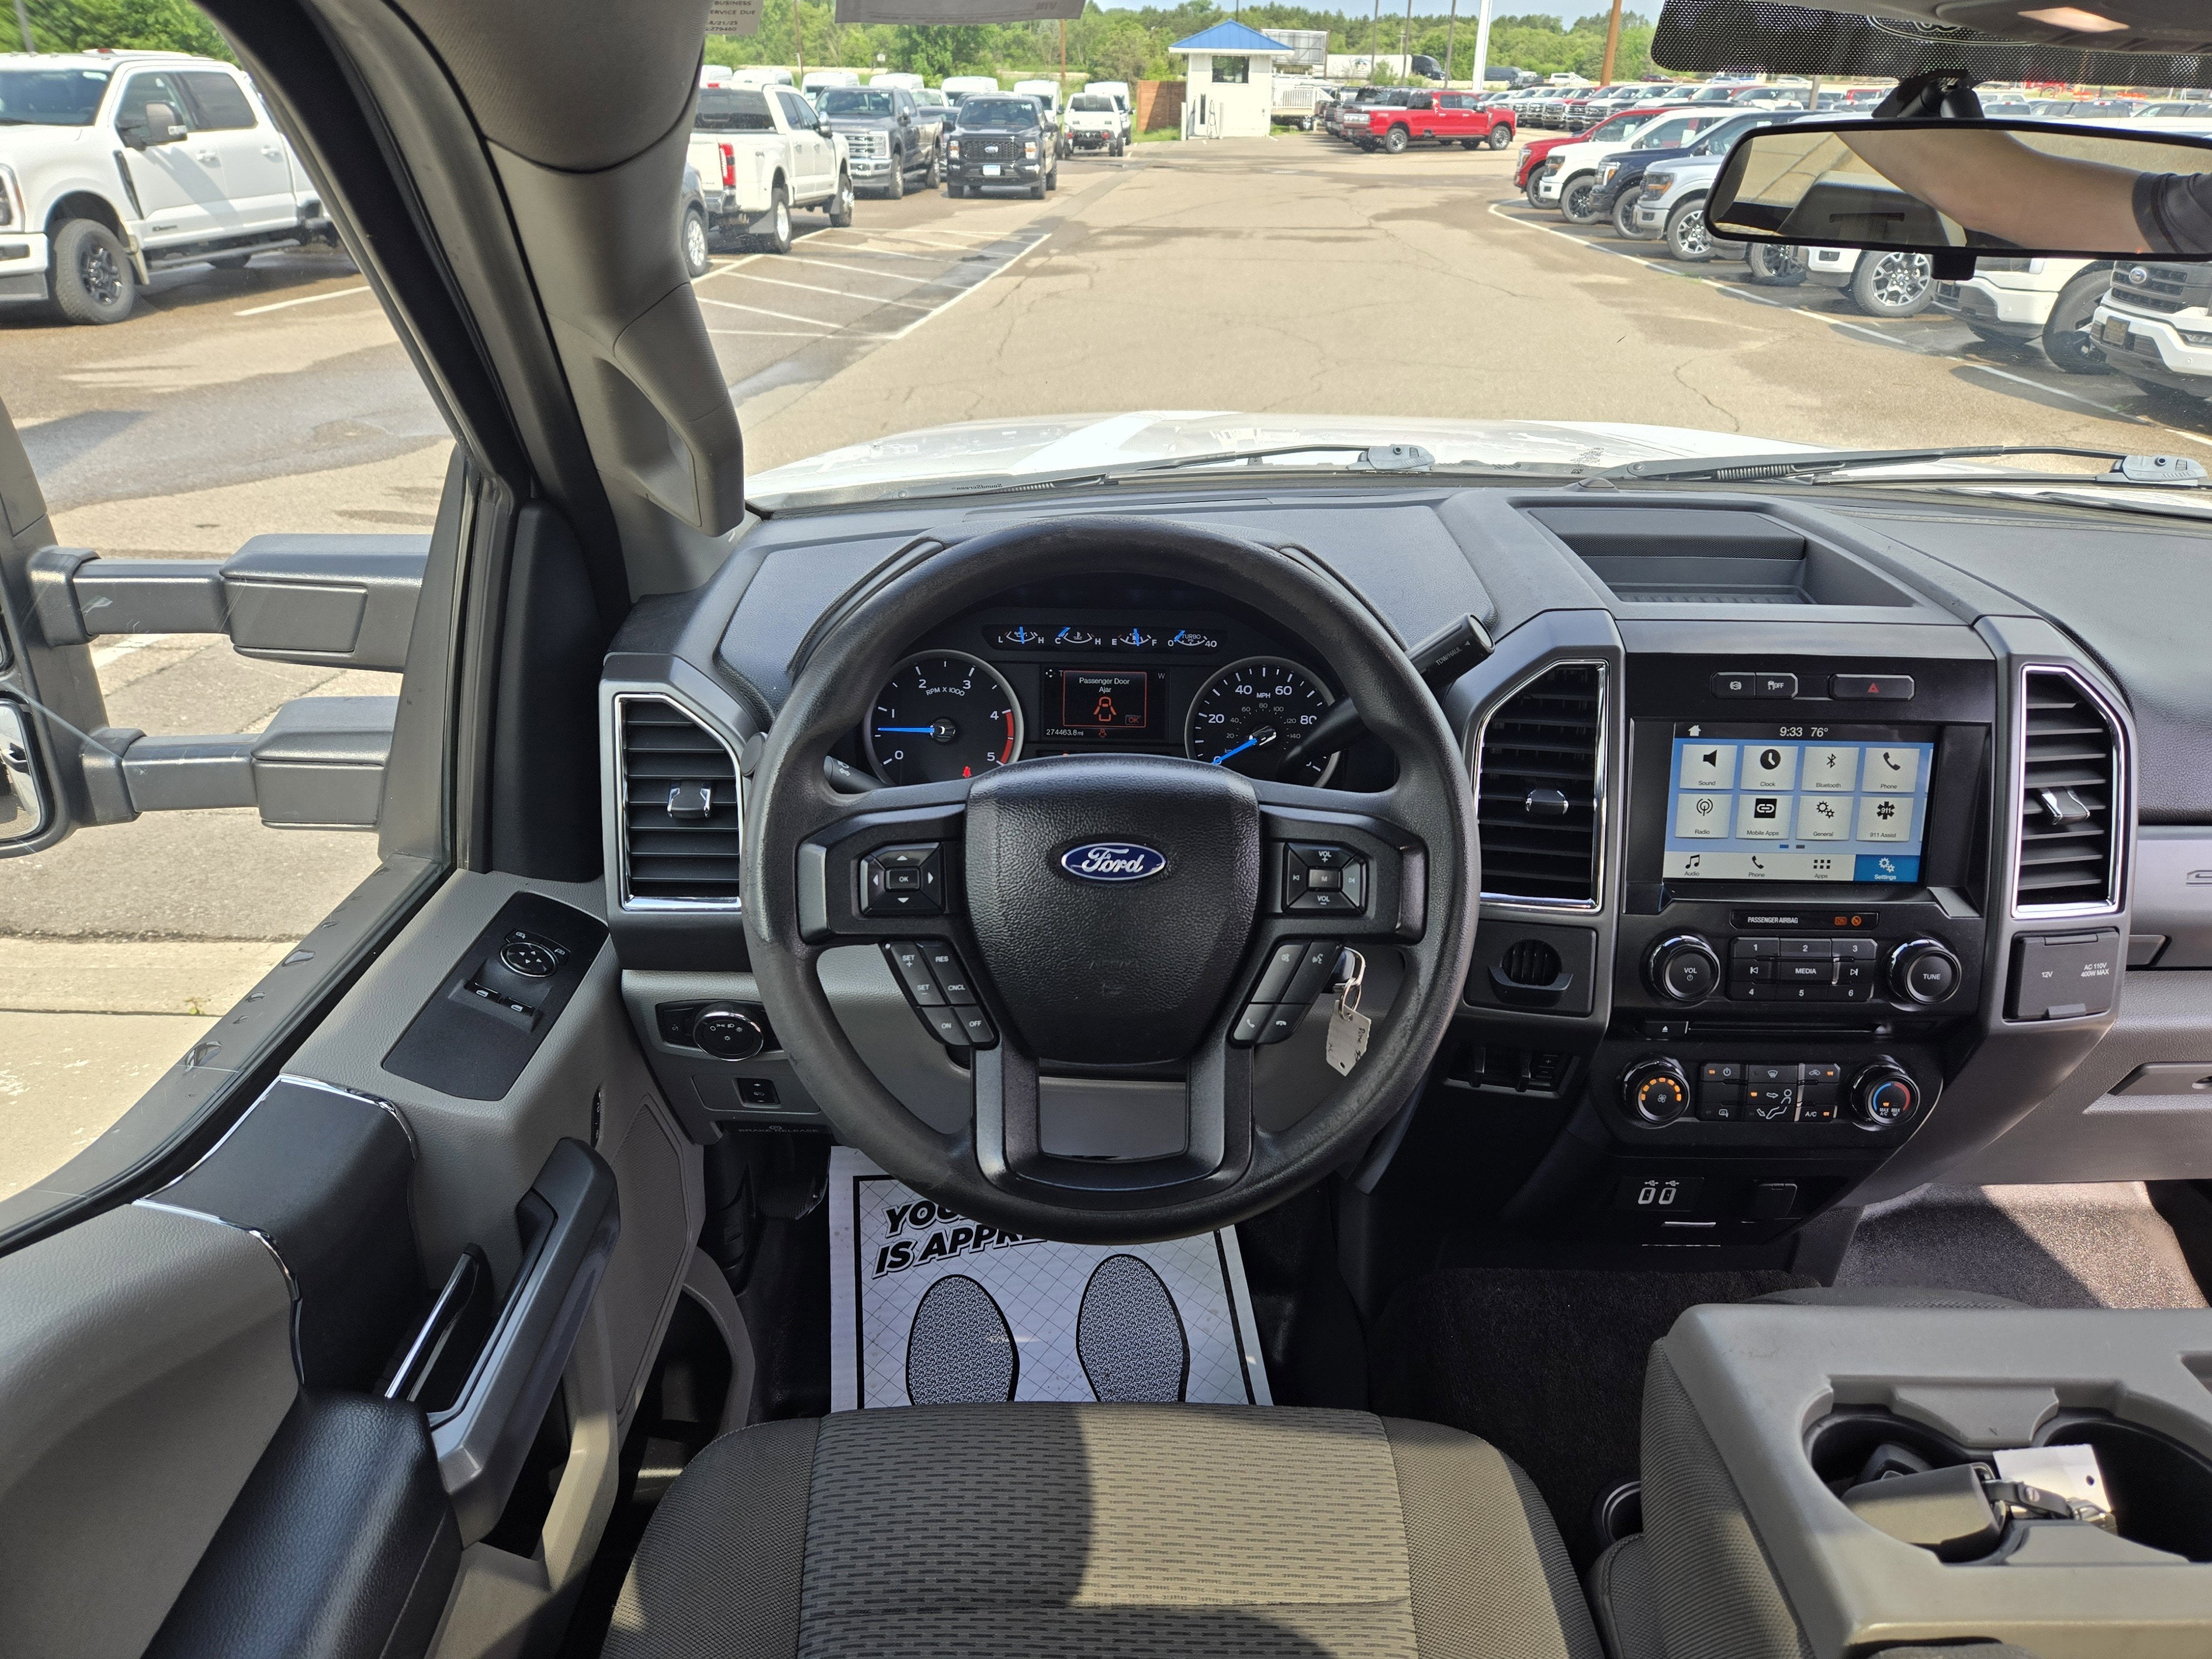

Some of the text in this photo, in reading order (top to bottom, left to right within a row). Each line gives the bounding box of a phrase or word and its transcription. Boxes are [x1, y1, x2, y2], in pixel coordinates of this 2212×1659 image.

[1435, 646, 1463, 666] TOW/HAUL
[919, 679, 926, 688] 2
[963, 680, 971, 689] 3
[1079, 677, 1112, 685] Passenger
[926, 687, 940, 696] RPM
[949, 687, 965, 696] 1000
[1235, 685, 1253, 695] 40
[1275, 686, 1292, 696] 60
[891, 708, 895, 718] 1
[990, 711, 999, 720] 4
[1208, 714, 1225, 724] 20
[1780, 727, 1829, 737] 9:33 76°
[894, 750, 904, 760] 0
[987, 752, 995, 761] 5
[1071, 847, 1145, 873] Ford
[885, 1200, 962, 1235] YOU
[875, 1224, 1026, 1275] IS APPR
